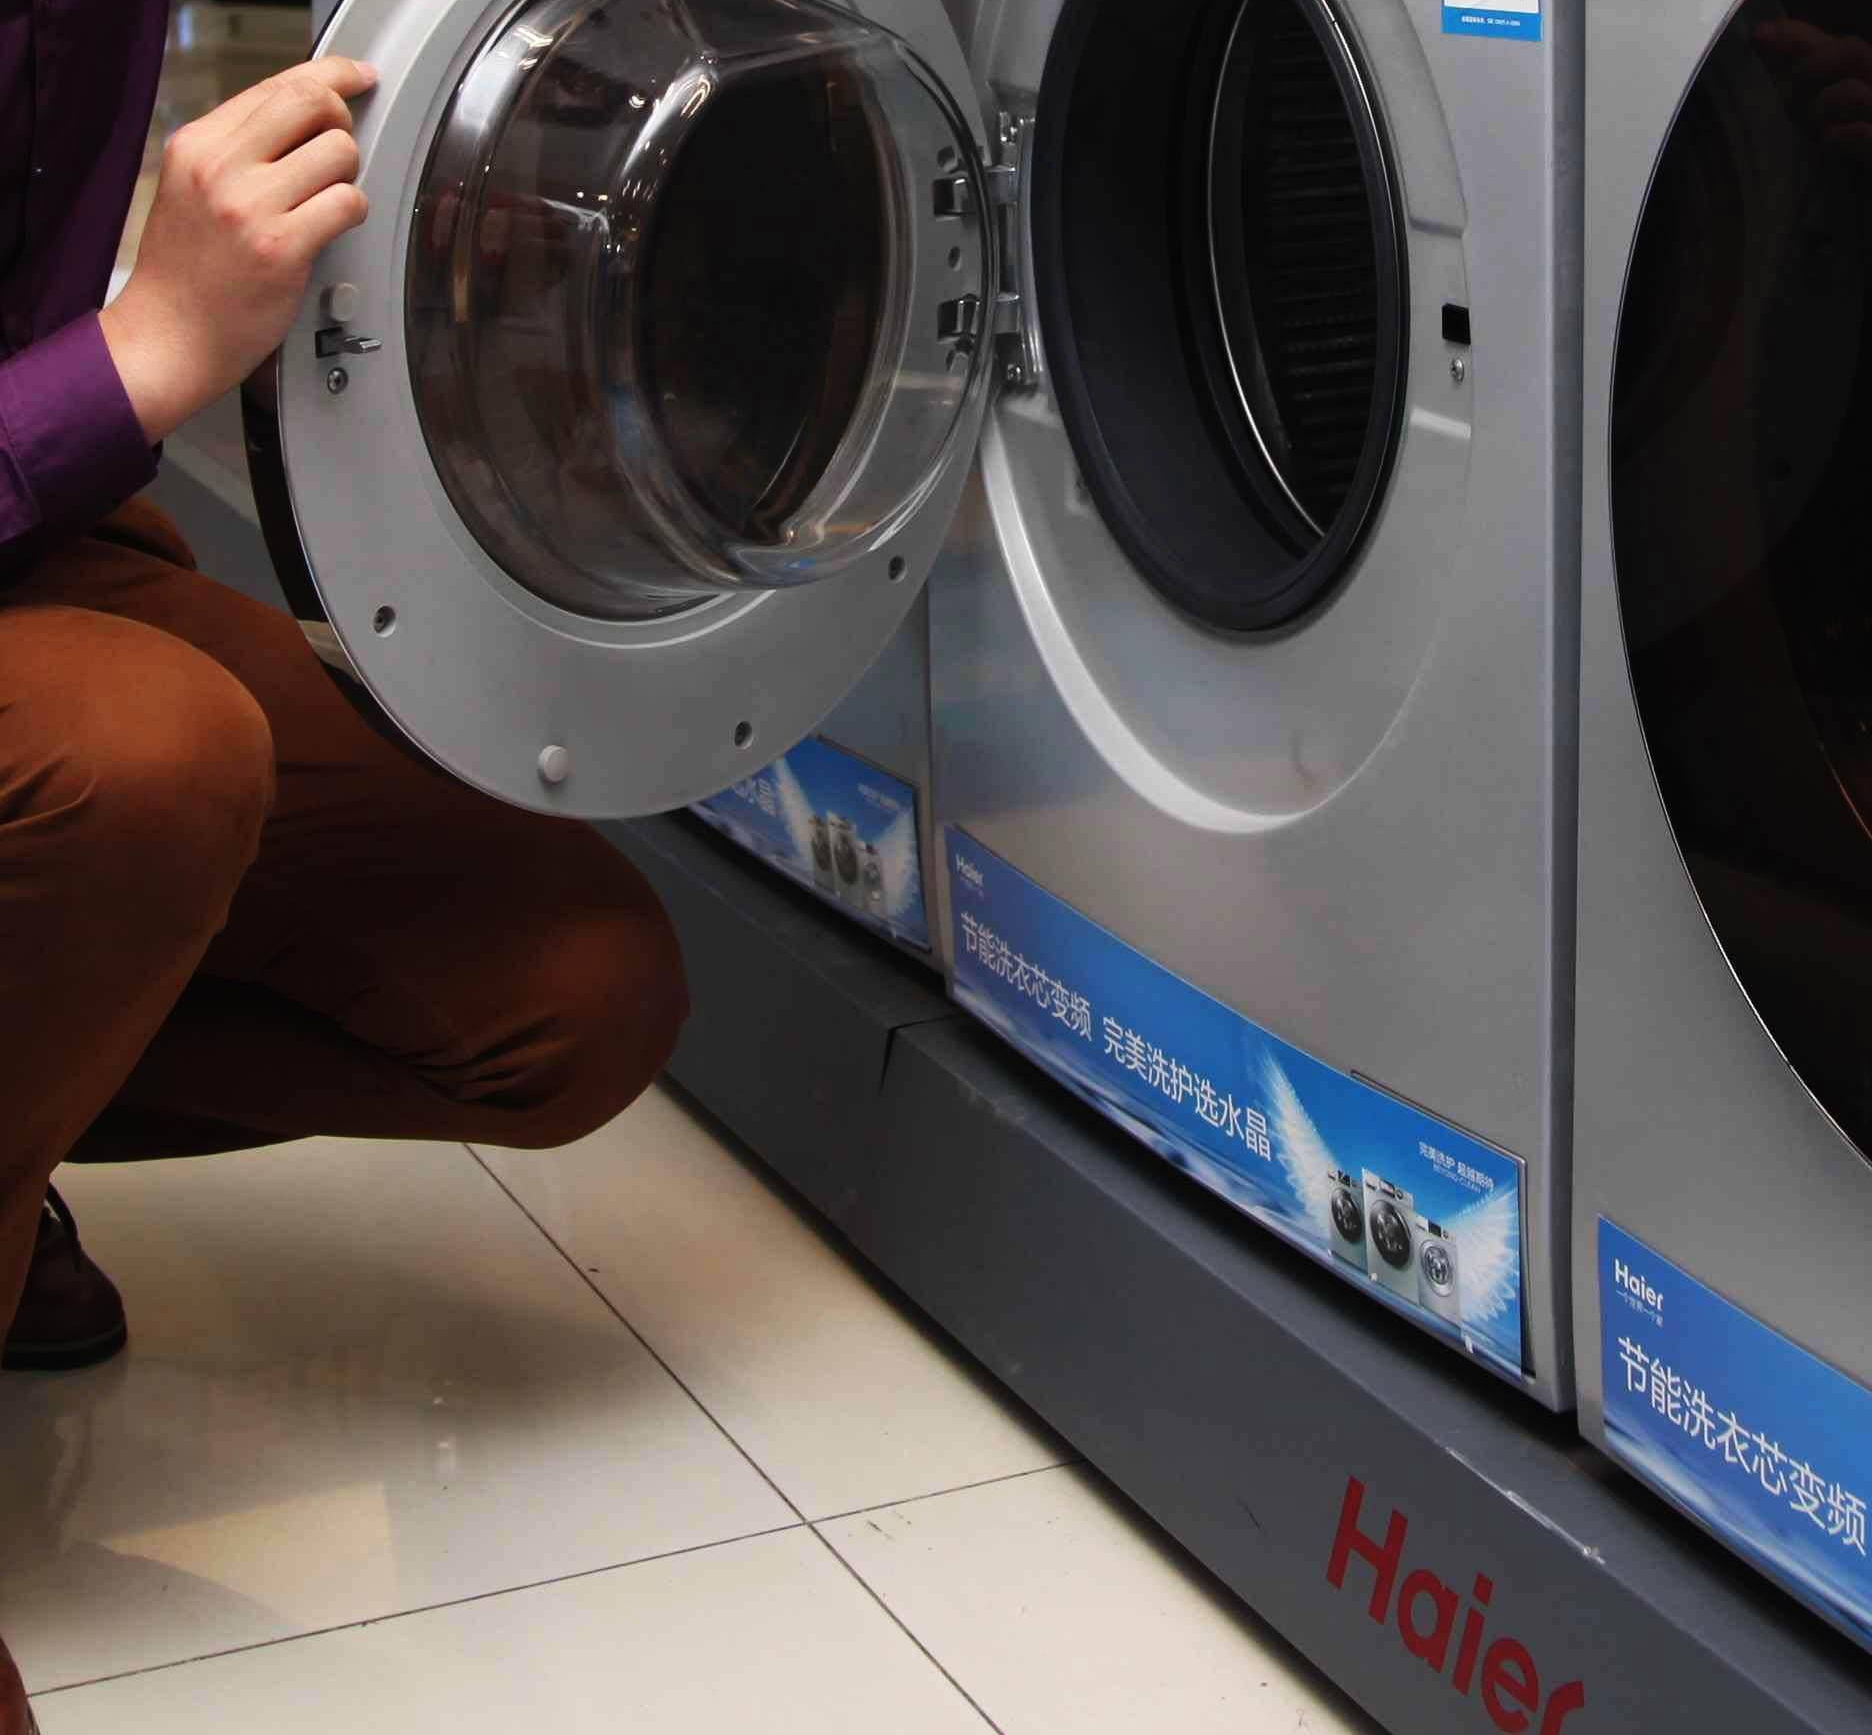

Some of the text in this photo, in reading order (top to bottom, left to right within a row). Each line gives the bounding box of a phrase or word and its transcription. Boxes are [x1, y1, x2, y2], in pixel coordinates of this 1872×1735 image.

[960, 912, 1274, 1163] 节能洗衣芯变频 完美洗护选水晶
[1614, 1258, 1664, 1312] Haier
[1619, 1335, 1867, 1557] 节能洗衣芯变频
[1326, 1475, 1585, 1735] Haier
